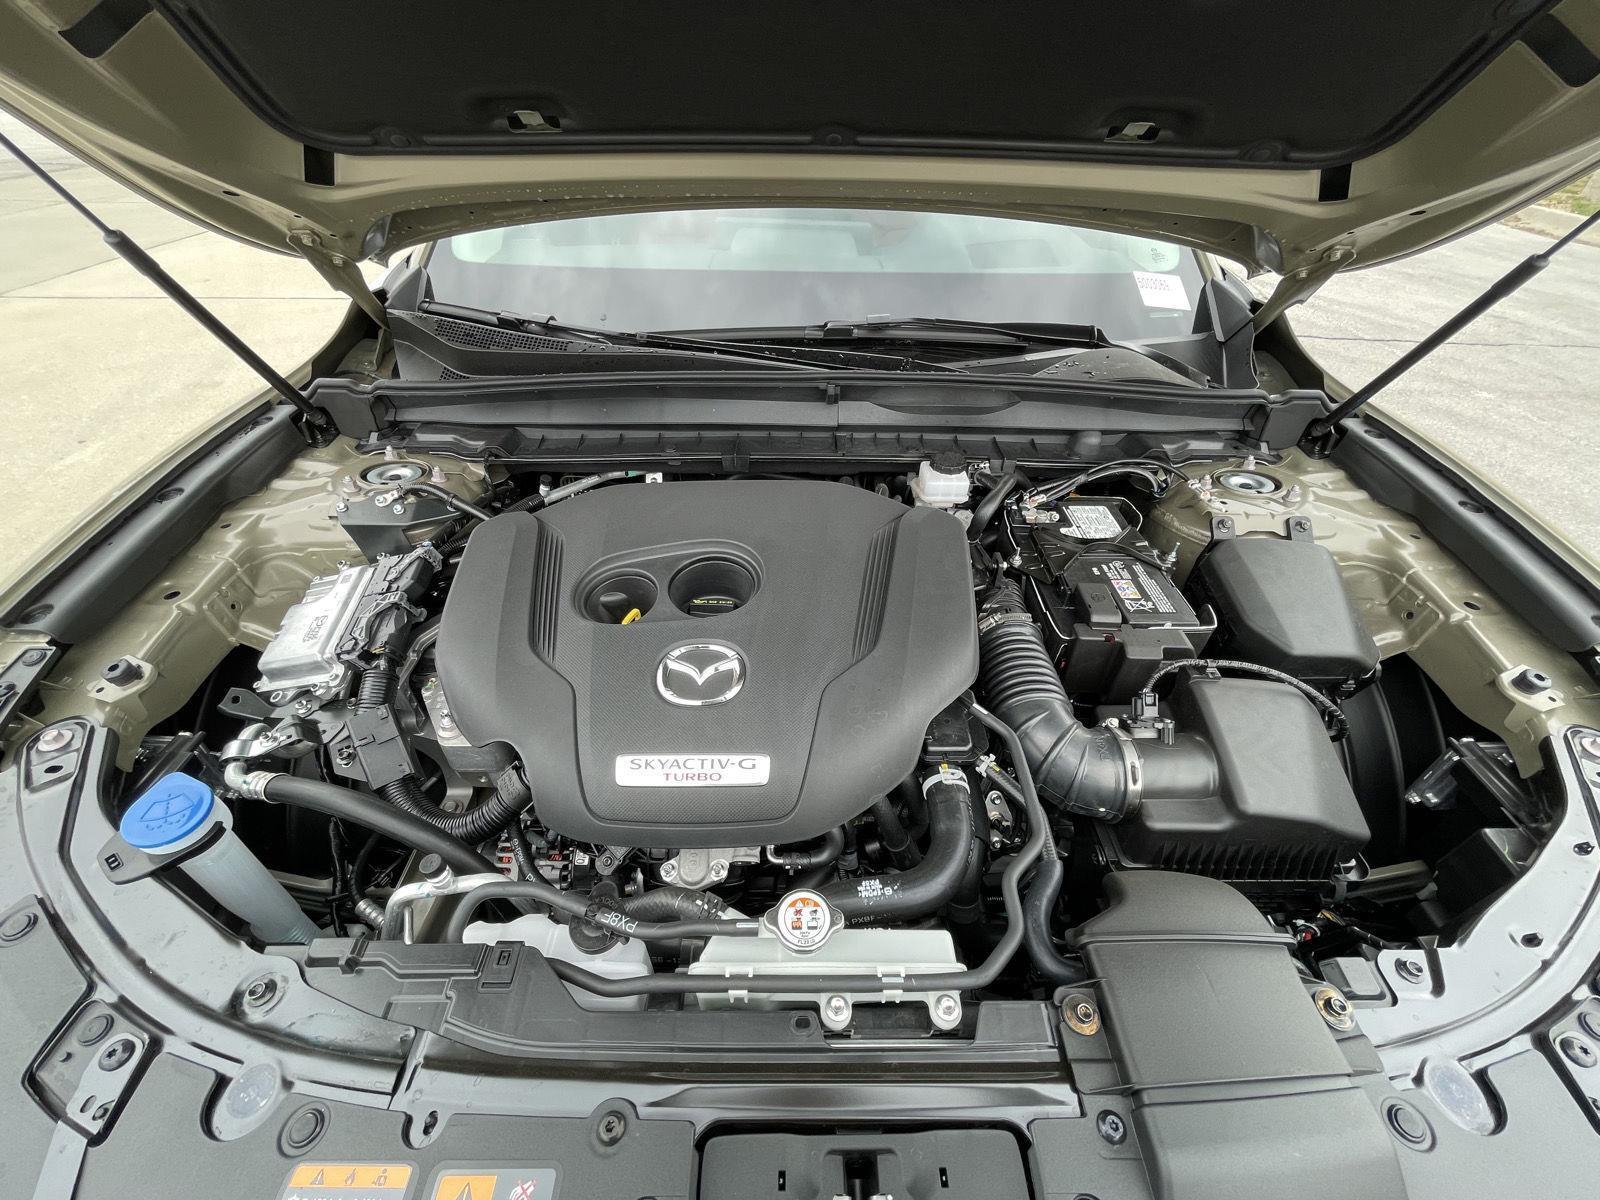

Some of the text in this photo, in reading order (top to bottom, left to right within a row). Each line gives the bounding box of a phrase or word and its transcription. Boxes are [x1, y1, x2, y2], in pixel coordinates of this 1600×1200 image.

[629, 758, 757, 770] SKYACTIV-G
[663, 773, 722, 782] TURBO
[600, 911, 638, 933] PX8F
